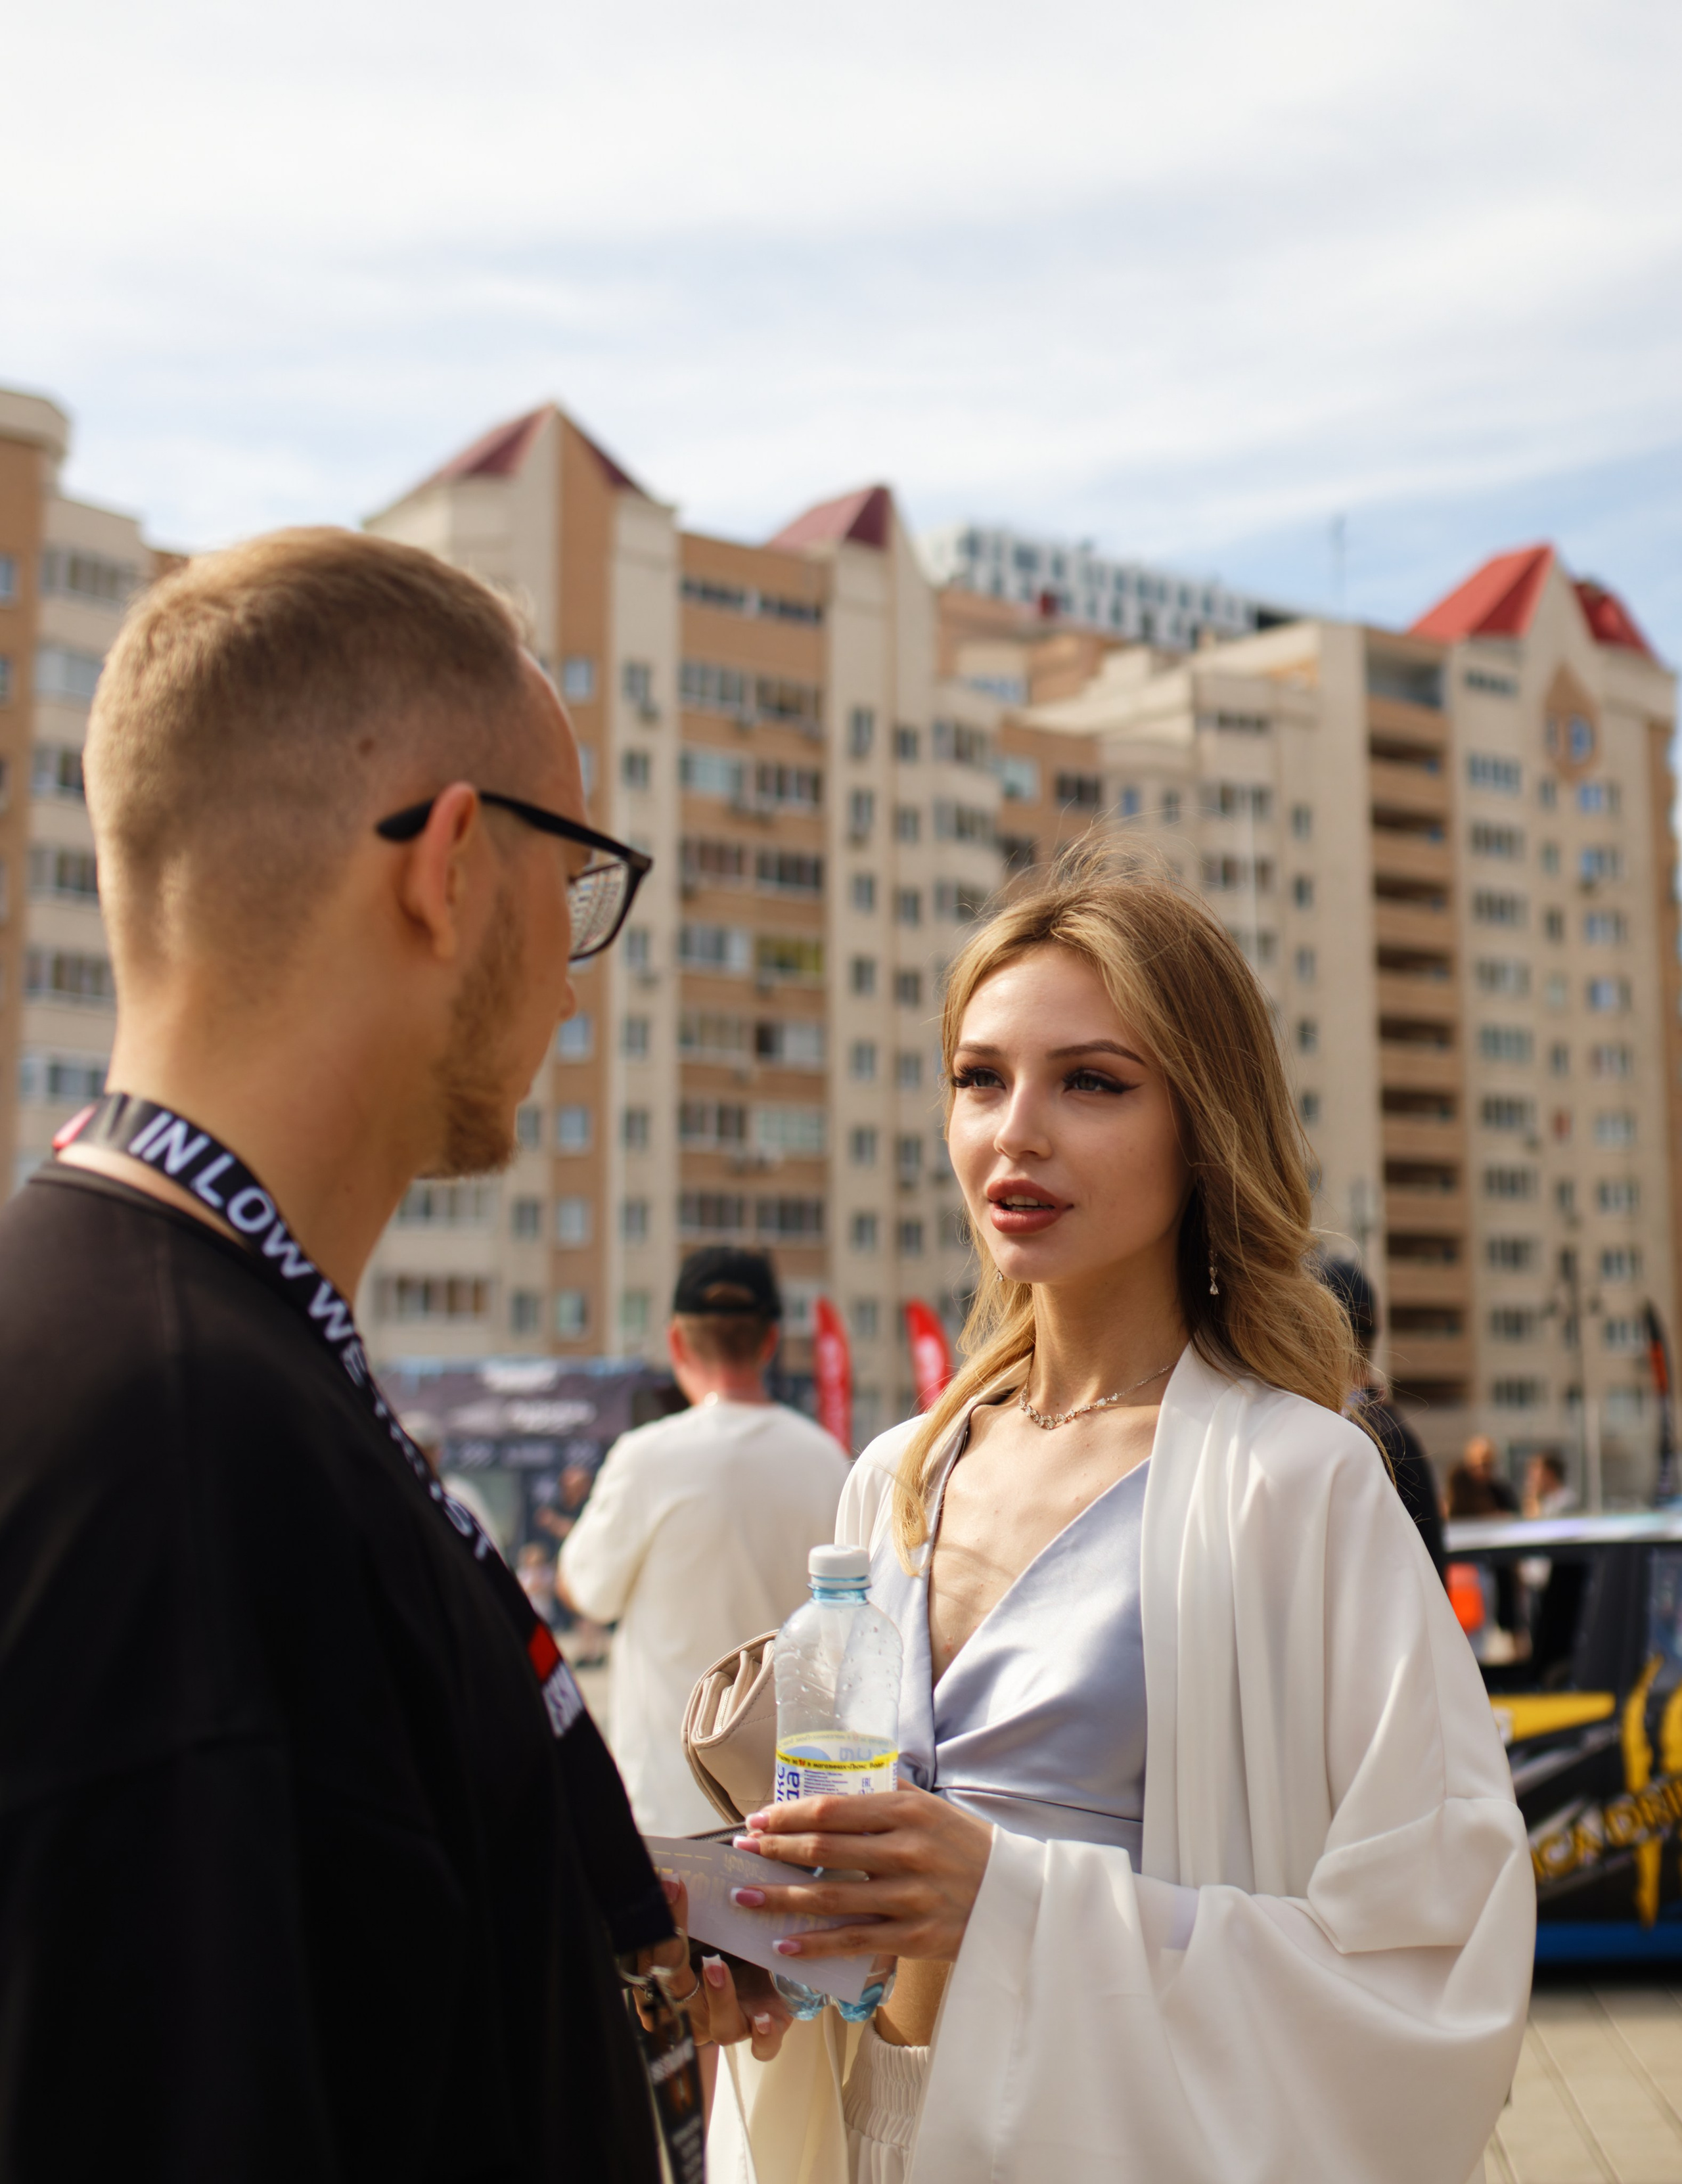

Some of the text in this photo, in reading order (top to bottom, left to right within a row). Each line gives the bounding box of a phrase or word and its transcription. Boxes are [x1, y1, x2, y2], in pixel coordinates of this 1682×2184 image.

[129, 1110, 211, 1175] IN
[191, 1152, 316, 1279] LOW
[309, 1279, 366, 1386] WE
